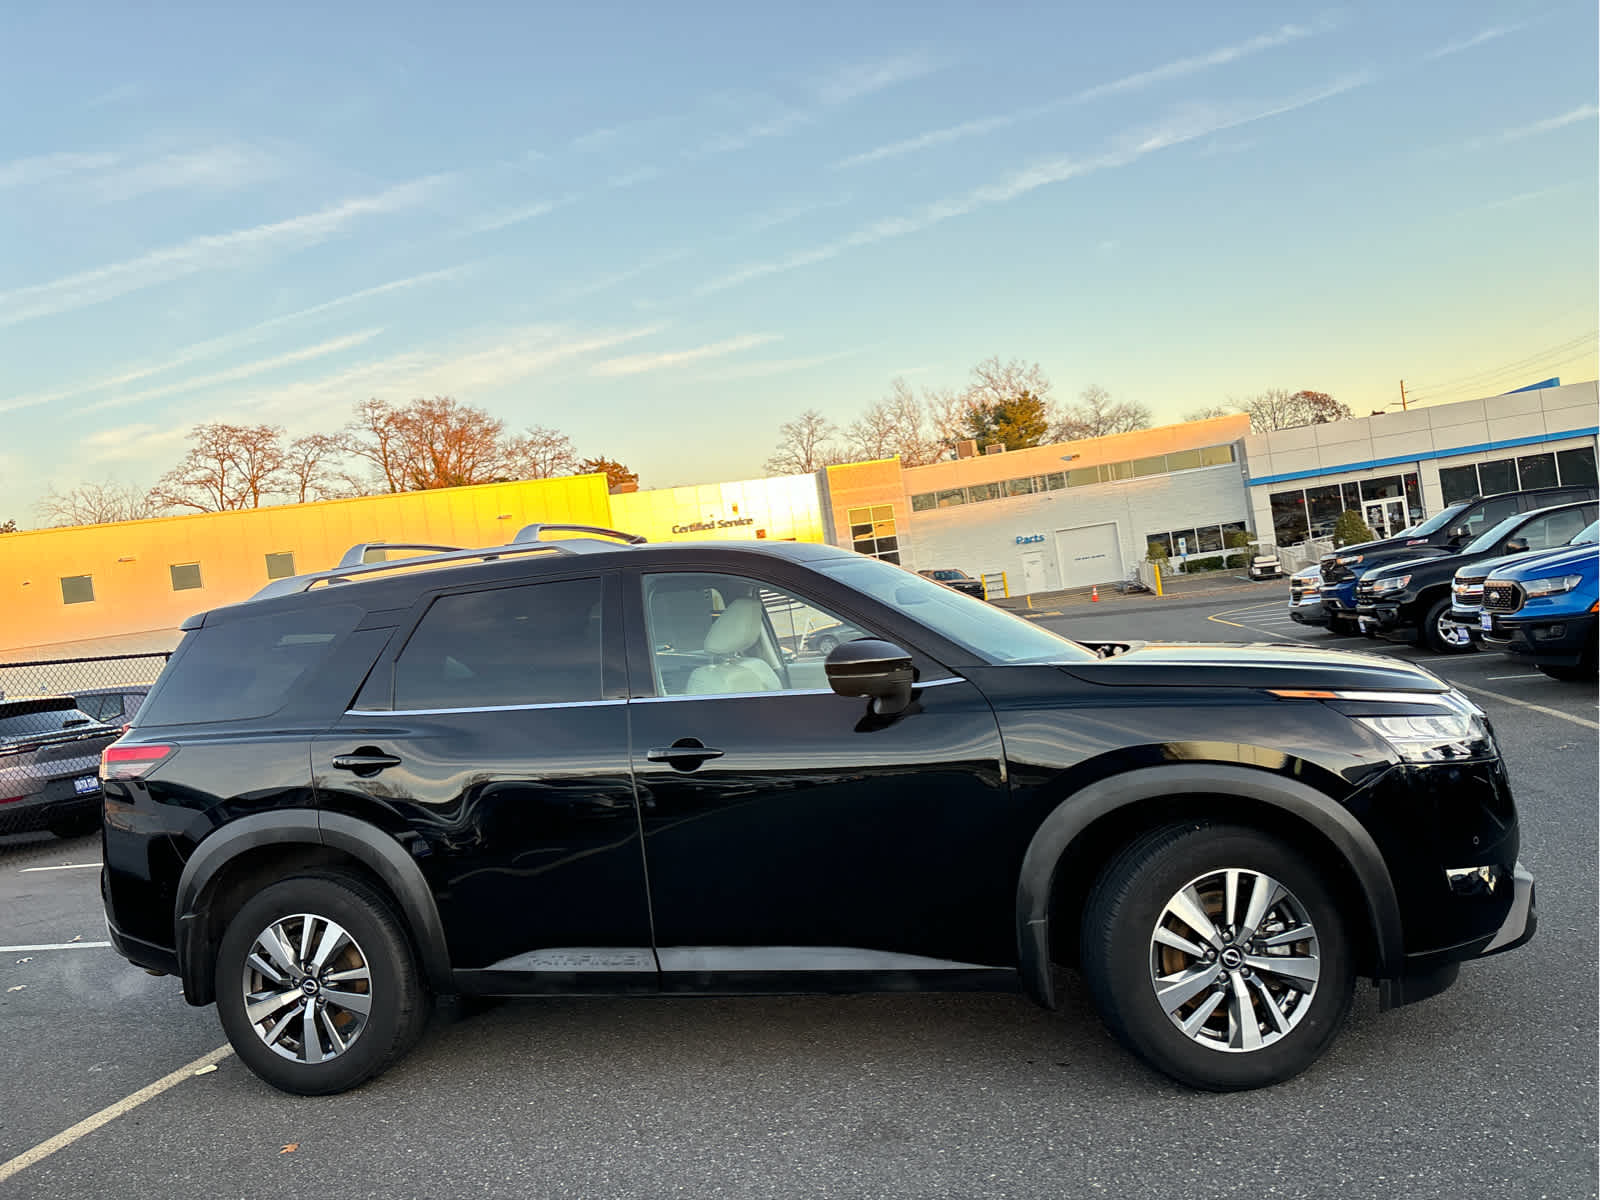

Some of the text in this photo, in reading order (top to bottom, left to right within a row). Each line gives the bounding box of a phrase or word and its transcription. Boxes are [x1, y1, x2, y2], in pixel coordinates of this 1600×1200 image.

[672, 517, 753, 534] Certified Service
[1015, 534, 1045, 544] Parts
